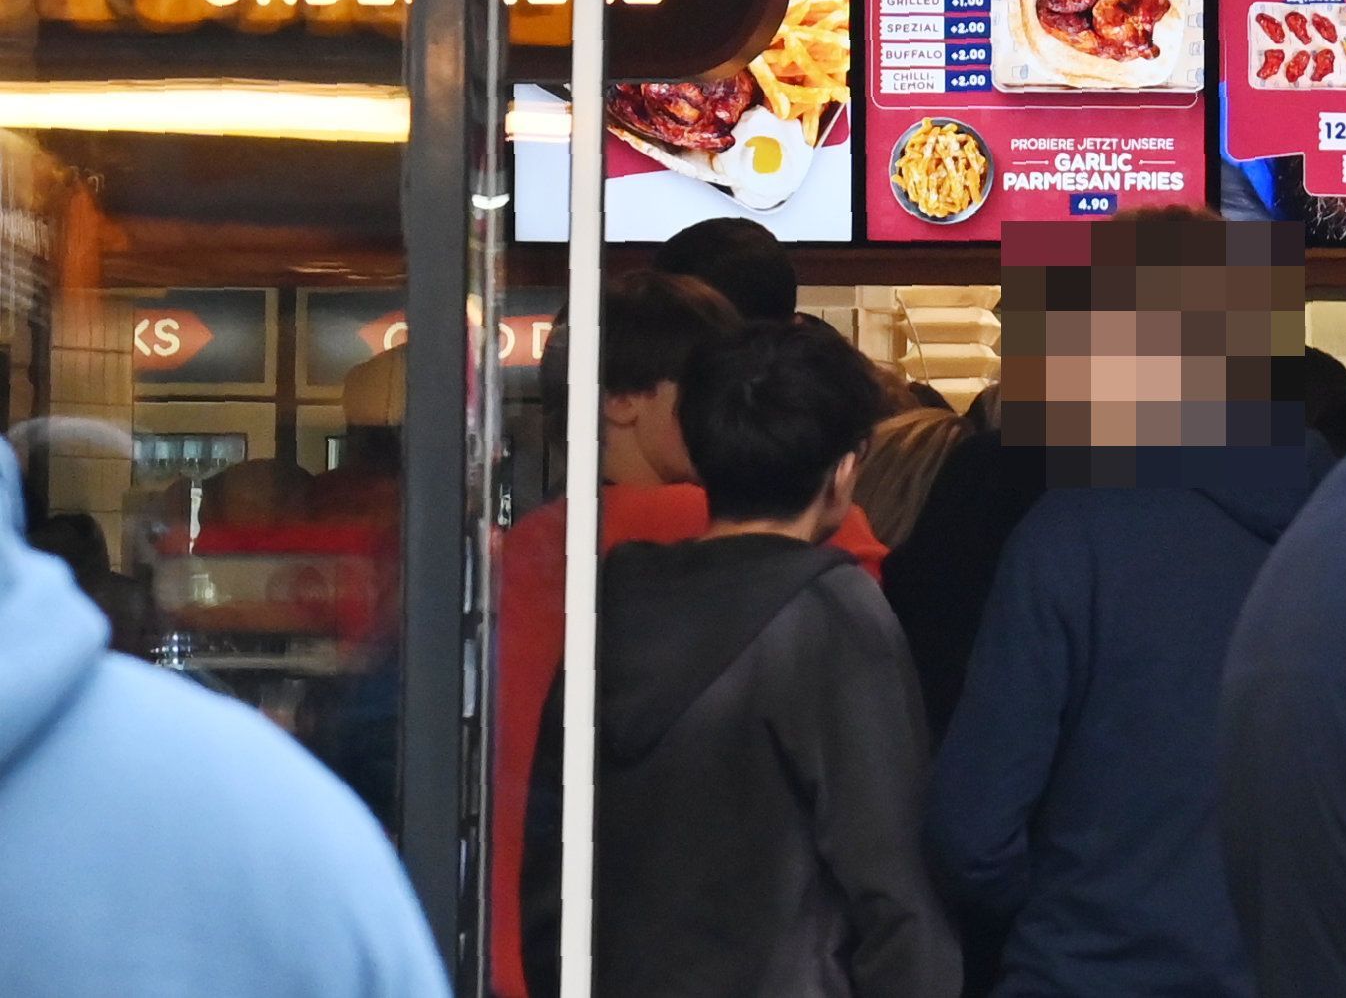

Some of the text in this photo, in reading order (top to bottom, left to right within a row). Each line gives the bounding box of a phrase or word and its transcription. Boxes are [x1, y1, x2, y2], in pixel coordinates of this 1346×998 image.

[887, 21, 985, 34] SPEZIAL +2.00
[886, 48, 986, 61] BUFFALO +2.00
[893, 71, 986, 87] CHILLI- +2.00
[893, 81, 935, 91] LEMON
[1011, 137, 1174, 151] PROBIERE JETZT UNSERE
[1054, 153, 1133, 172] GARLIC
[1003, 170, 1185, 192] PARMESAN FRIES
[1078, 197, 1109, 211] 4.90
